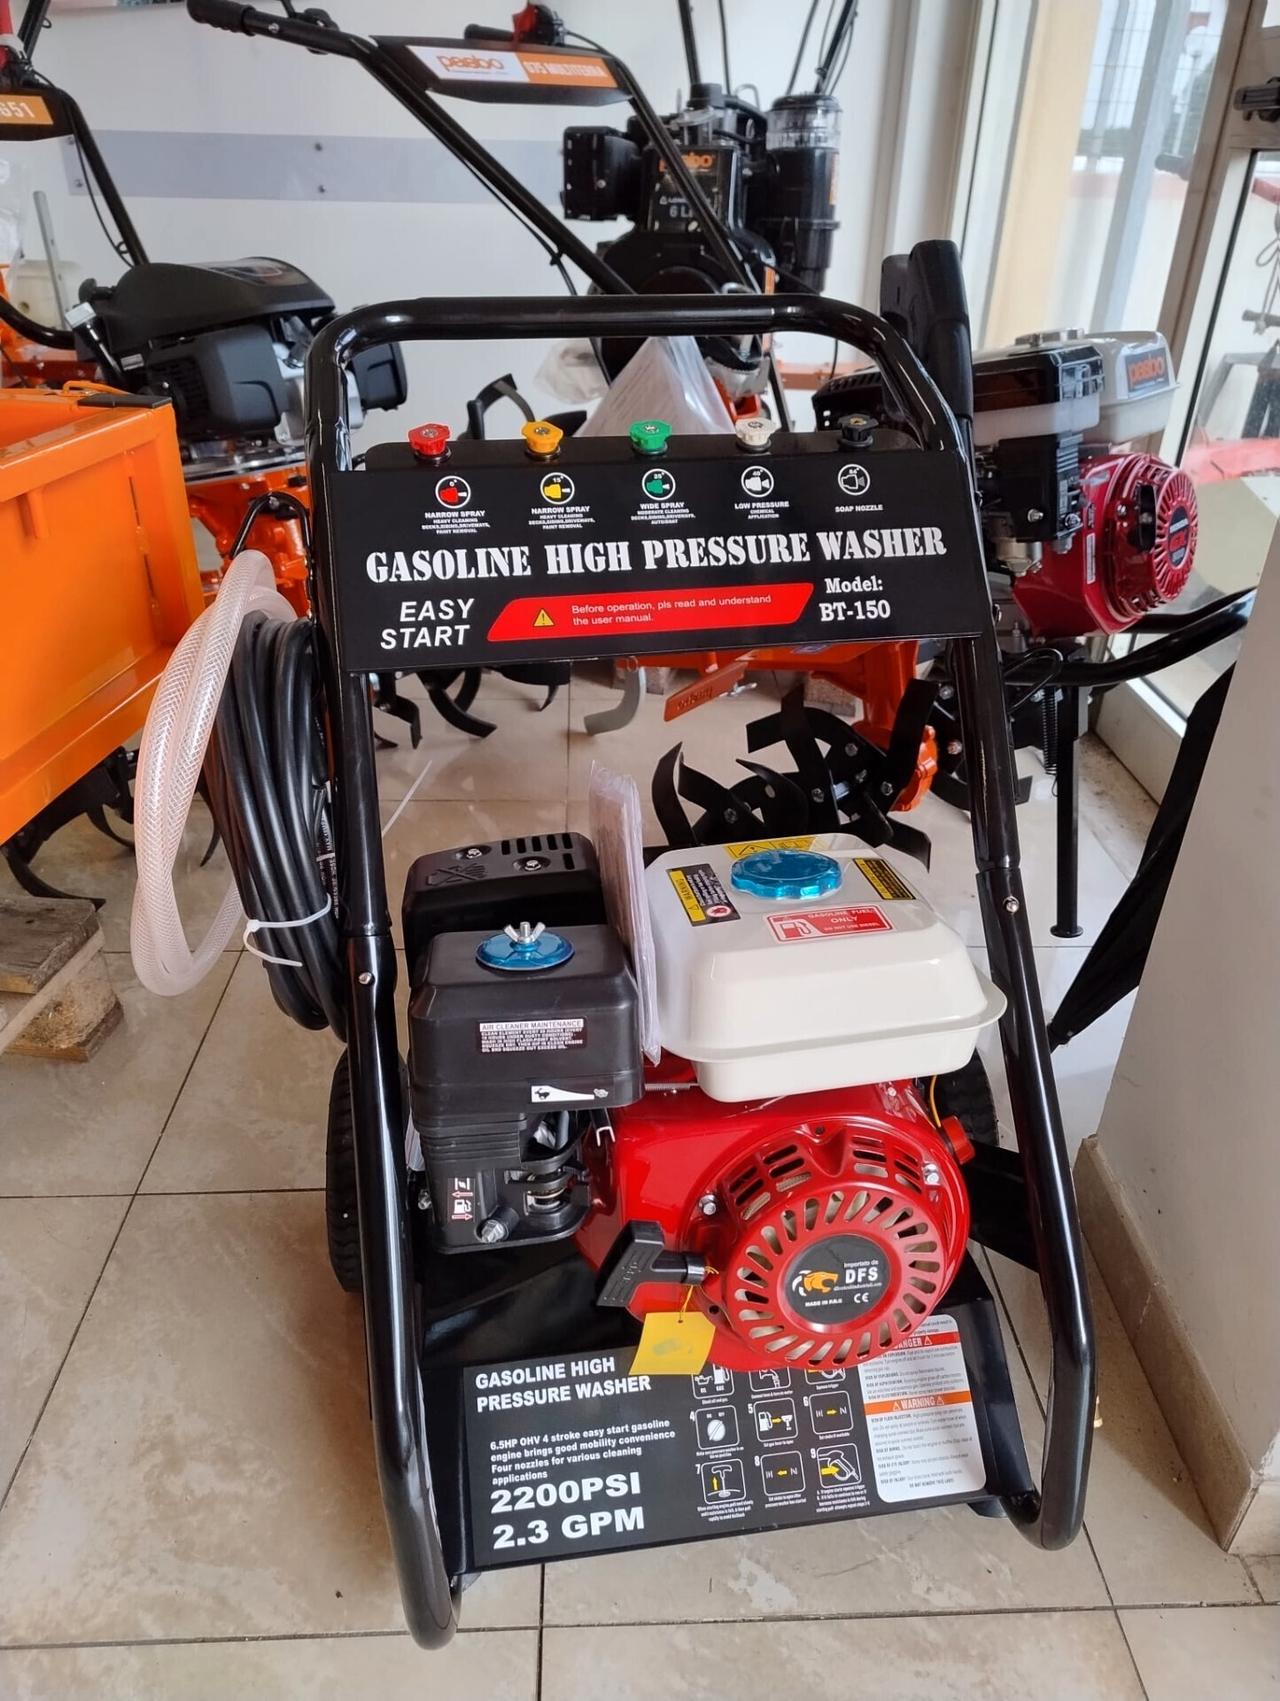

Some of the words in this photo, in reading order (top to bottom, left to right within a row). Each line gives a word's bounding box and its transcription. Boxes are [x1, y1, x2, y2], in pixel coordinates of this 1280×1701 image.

[531, 507, 565, 515] NARROW
[565, 505, 590, 513] SPRAY
[660, 501, 685, 509] SPRAY
[751, 501, 790, 509] PRESSURE
[855, 504, 884, 512] NOZZLE
[424, 511, 459, 519] NARROW
[460, 510, 486, 518] SPRAY
[366, 545, 533, 584] GASOLINE
[544, 541, 632, 575] HIGH
[641, 533, 811, 570] PRESSURE
[816, 526, 948, 561] WASHER
[824, 575, 885, 593] Model:
[400, 598, 475, 622] EASY
[571, 604, 605, 614] Before
[657, 601, 672, 611] pls
[674, 599, 696, 608] read
[698, 598, 716, 607] and
[719, 595, 772, 606] understand
[819, 599, 892, 623] BT-150
[573, 617, 589, 626] the
[591, 616, 613, 625] user
[380, 625, 470, 650] START
[530, 1020, 581, 1029] MAINTENANCE
[845, 1266, 879, 1284] DFS
[894, 1337, 922, 1349] ANGER
[475, 1363, 566, 1389] GASOLINE
[571, 1357, 616, 1377] HIGH
[476, 1386, 571, 1413] PRESSURE
[575, 1376, 651, 1400] WASHER
[803, 1396, 809, 1407] 6
[747, 1403, 753, 1414] 5
[901, 1396, 935, 1409] WARNING
[689, 1411, 695, 1422] 4
[490, 1439, 518, 1451] 6.5HP
[519, 1436, 540, 1447] OHV
[542, 1435, 549, 1444] 4
[551, 1431, 580, 1443] stroke
[582, 1428, 604, 1440] easy
[606, 1424, 629, 1436] start
[631, 1420, 670, 1434] gasoline
[490, 1451, 522, 1463] engine
[524, 1445, 552, 1459] brings
[555, 1442, 578, 1456] good
[579, 1436, 616, 1451] mobility
[619, 1430, 675, 1445] convenience
[810, 1448, 816, 1459] 9
[491, 1462, 512, 1474] Four
[514, 1458, 549, 1470] nozzles
[551, 1455, 564, 1466] for
[566, 1451, 601, 1463] various
[603, 1446, 642, 1459] cleaning
[754, 1455, 760, 1466] 8
[695, 1463, 701, 1474] 7
[492, 1470, 548, 1486] applications
[490, 1471, 641, 1514] 2200PSI
[493, 1520, 549, 1549] 2.3
[561, 1506, 645, 1538] GPM
